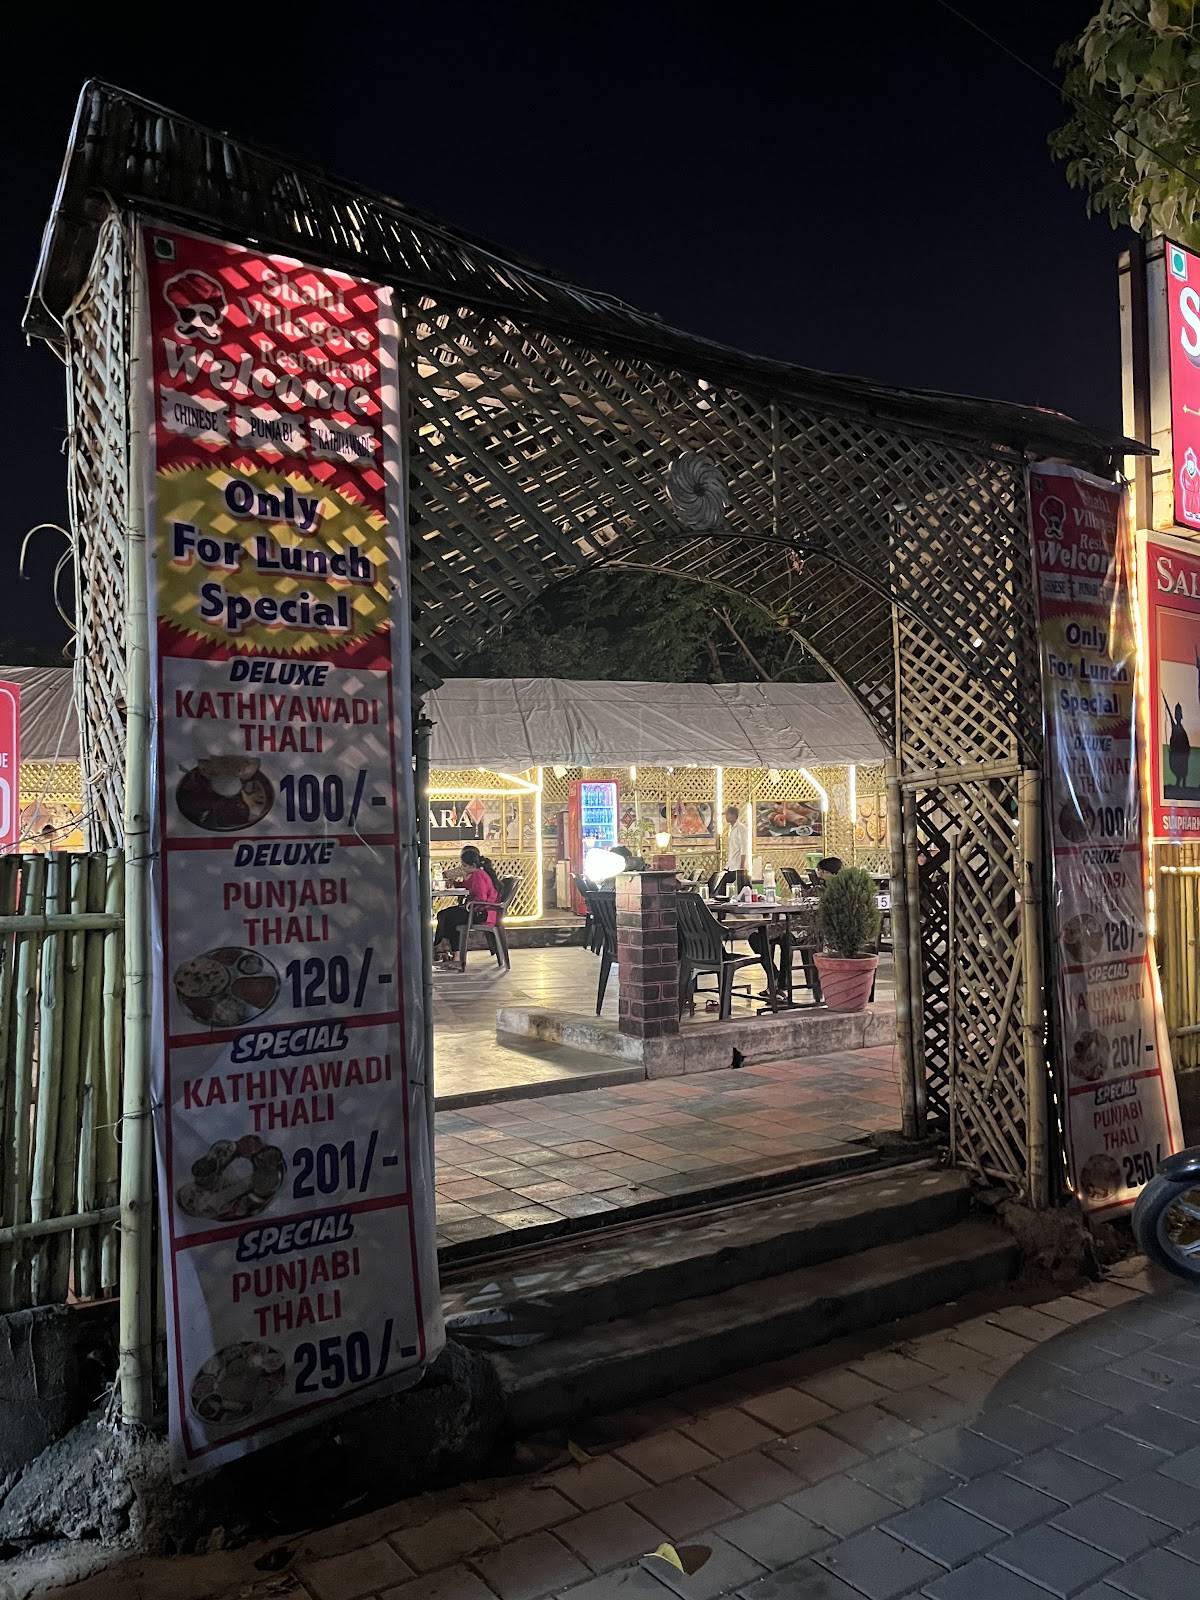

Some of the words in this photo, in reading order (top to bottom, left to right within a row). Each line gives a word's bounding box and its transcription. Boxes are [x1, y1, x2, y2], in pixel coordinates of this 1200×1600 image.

[262, 269, 347, 315] Shahi
[238, 296, 370, 350] Villagers
[162, 337, 369, 416] Welcome
[260, 340, 372, 384] Restaurant
[174, 403, 219, 432] CHINESE
[251, 417, 293, 442] PUNJABI
[224, 480, 320, 530] Only
[174, 522, 241, 566] For
[256, 536, 372, 580] Lunch
[201, 583, 349, 629] Special
[1066, 623, 1107, 652] Only
[230, 660, 329, 687] DELUXE
[1049, 653, 1073, 677] For
[1080, 658, 1128, 682] Lunch
[176, 690, 379, 726] KATHIYAWADI
[1061, 689, 1119, 716] Special
[240, 723, 323, 753] THALI
[279, 769, 386, 827] 100/-
[235, 842, 336, 868] DELUXE
[224, 878, 347, 913] PUNJABI
[881, 896, 888, 908] 5
[244, 915, 329, 946] THALI
[285, 947, 392, 1008] 120/-
[1088, 963, 1128, 983] SPECIAL
[234, 1023, 347, 1062] SPECIAL
[184, 1055, 391, 1110] KATHIYAWADI
[1096, 1078, 1137, 1106] SPECIAL
[249, 1094, 335, 1132] THALI
[1094, 1100, 1143, 1131] PUNJABI
[1103, 1126, 1139, 1151] THALI
[292, 1130, 398, 1199] 201/-
[239, 1214, 352, 1259] SPECIAL
[232, 1248, 360, 1303] PUNJABI
[254, 1290, 341, 1336] THALI
[294, 1318, 416, 1394] 250/-
